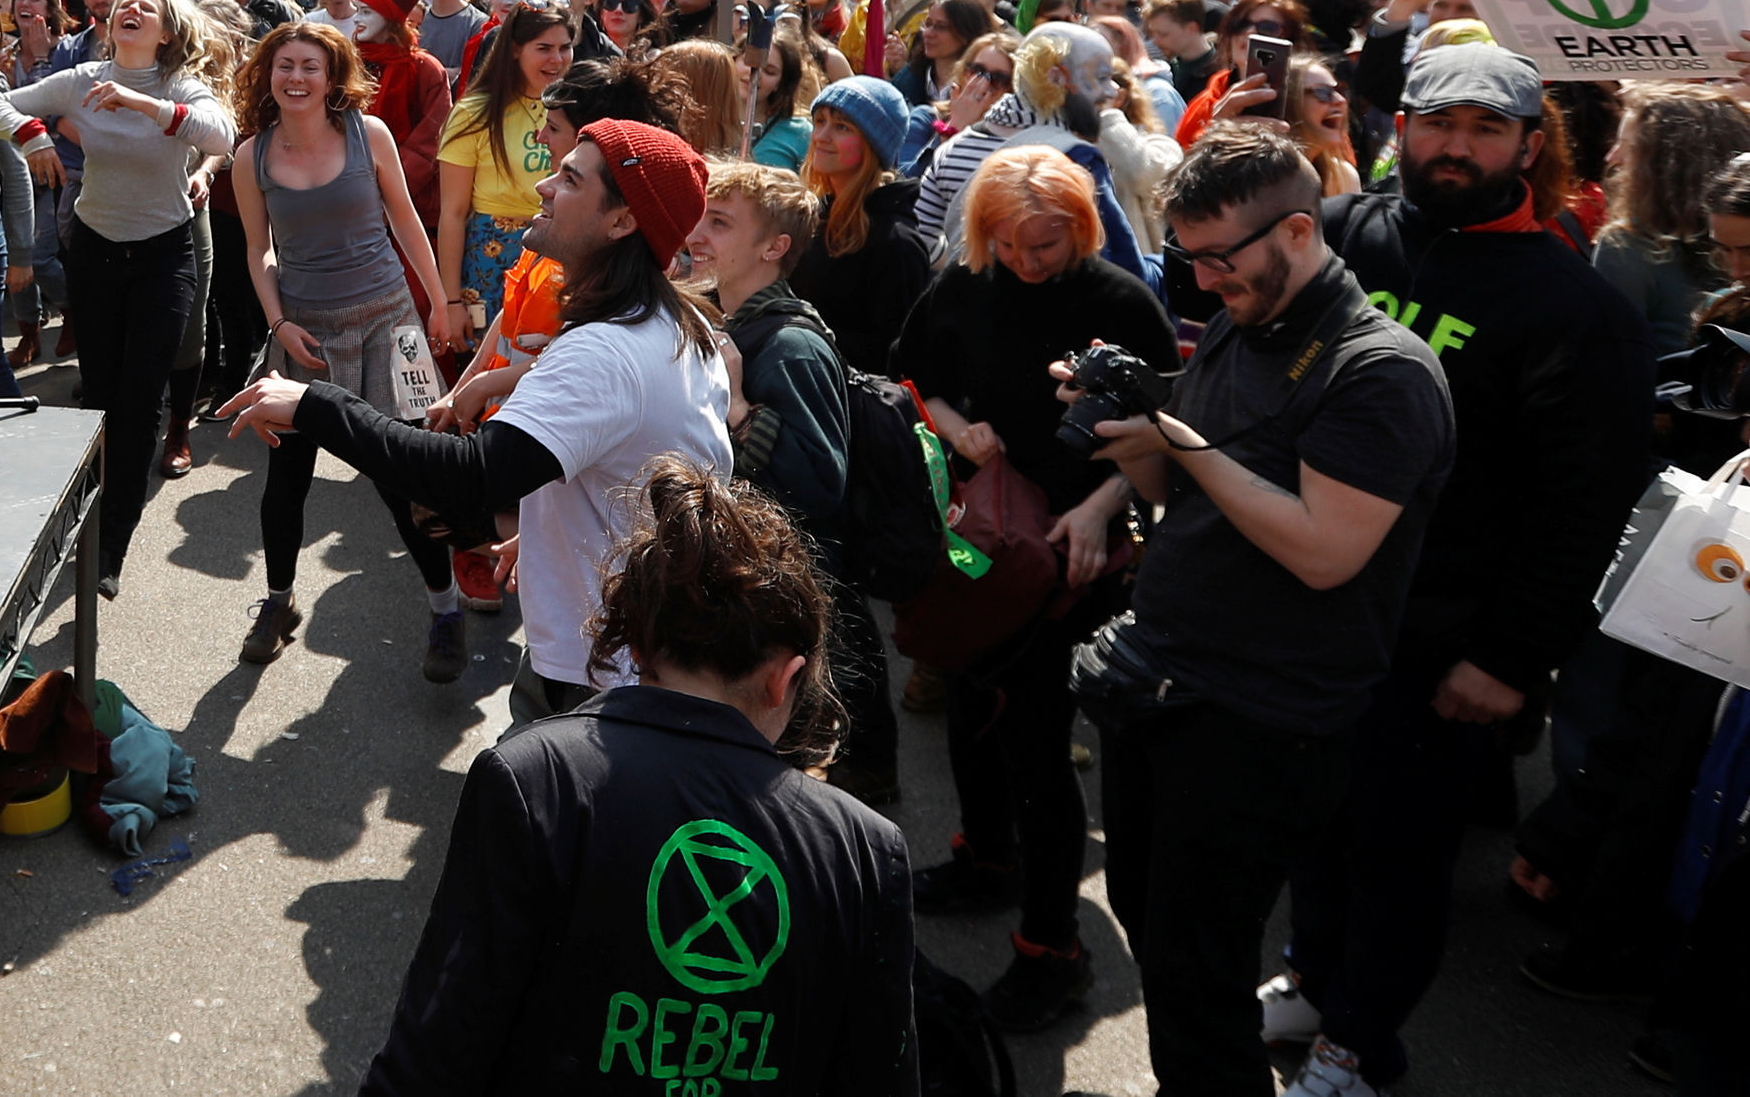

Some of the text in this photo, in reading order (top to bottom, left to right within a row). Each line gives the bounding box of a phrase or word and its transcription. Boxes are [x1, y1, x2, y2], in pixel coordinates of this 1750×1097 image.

[1554, 34, 1700, 58] EARTH
[1569, 58, 1710, 73] PROTECTORS
[1287, 339, 1325, 381] Nikon
[402, 370, 430, 385] TELL
[412, 387, 426, 395] THE
[409, 396, 437, 408] TRUTH
[599, 991, 779, 1081] REBEL
